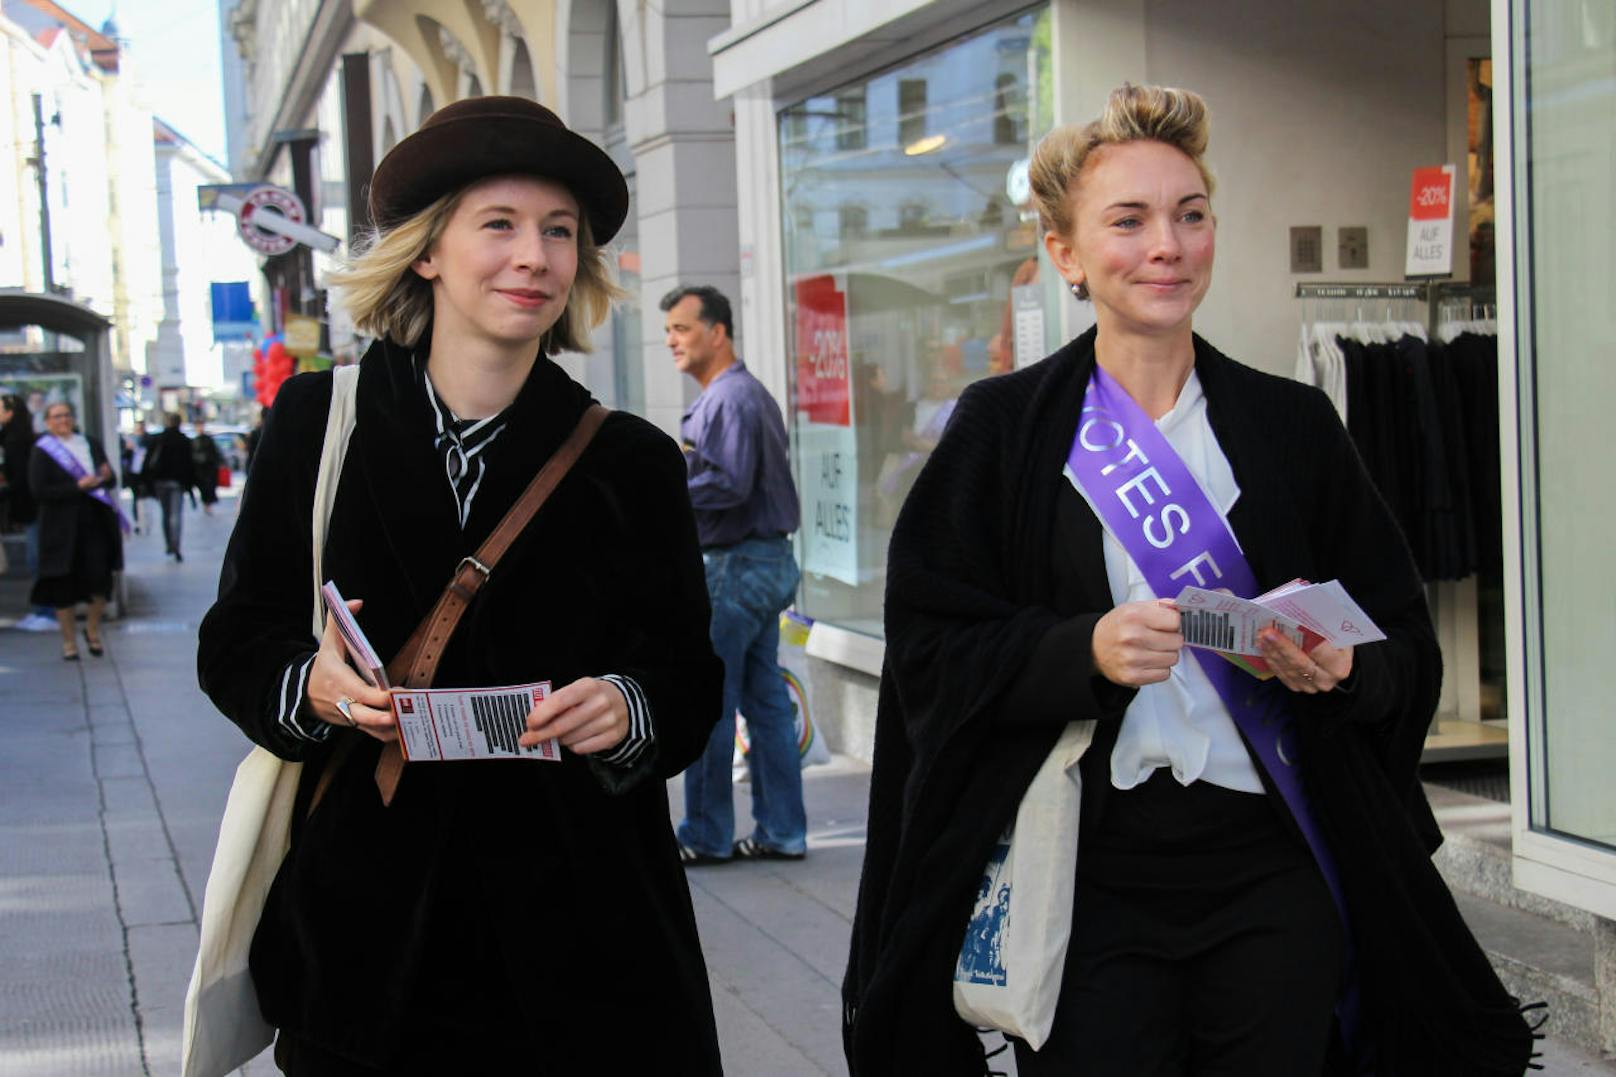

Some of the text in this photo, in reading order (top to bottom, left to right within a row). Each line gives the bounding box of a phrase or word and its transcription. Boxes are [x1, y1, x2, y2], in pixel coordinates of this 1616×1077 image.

[1417, 185, 1447, 207] -20%
[1419, 226, 1440, 241] AUF
[1413, 244, 1443, 260] ALLES
[821, 452, 843, 490] AUF
[814, 501, 851, 544] ALLES
